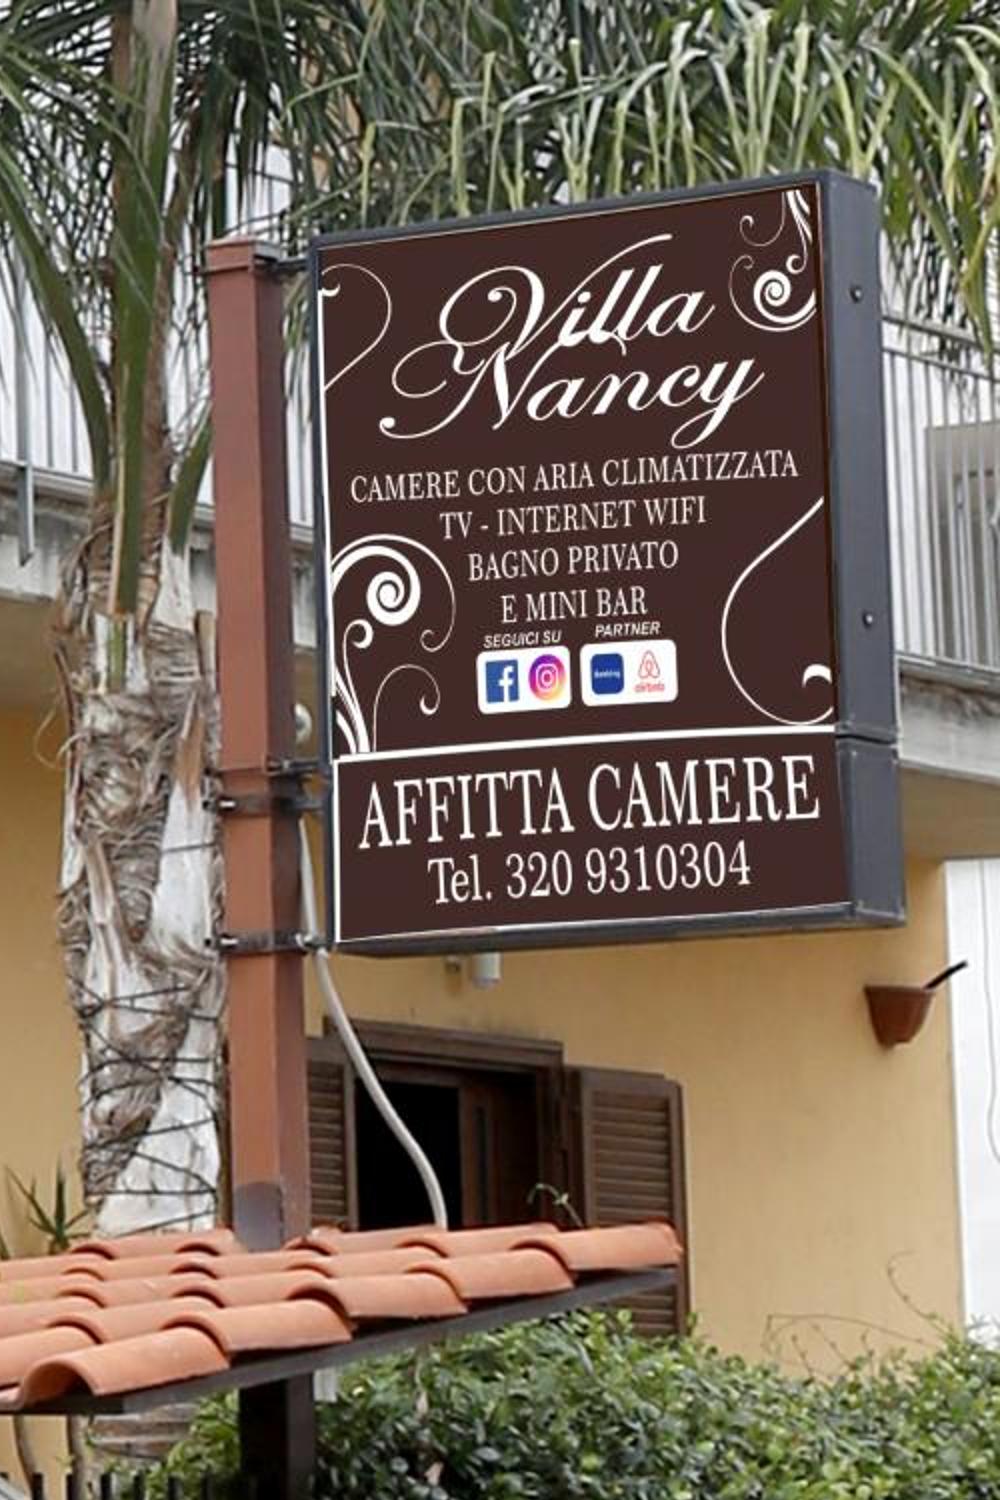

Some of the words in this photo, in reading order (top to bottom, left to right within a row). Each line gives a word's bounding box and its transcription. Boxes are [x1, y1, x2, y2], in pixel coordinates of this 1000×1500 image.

[439, 233, 715, 359] Villa
[378, 335, 765, 449] Nancy
[351, 470, 461, 503] CAMERE
[468, 466, 526, 496] CON
[533, 461, 595, 491] ARIA
[602, 449, 799, 487] CLIMATIZZATA
[439, 511, 473, 540] TV
[497, 499, 637, 536] INTERNET
[643, 495, 707, 526] WIFI
[468, 547, 560, 581] BAGNO
[567, 540, 679, 574] PRIVATO
[501, 594, 518, 624] E
[526, 589, 588, 622] MINI
[596, 585, 649, 617] BAR
[483, 631, 539, 649] SEGUICI
[543, 629, 563, 644] SU
[594, 621, 661, 638] PARTNER
[358, 766, 575, 849] AFFITTA
[587, 755, 821, 831] CAMERE
[427, 855, 493, 903] Tel.
[505, 849, 573, 900] 320
[585, 839, 751, 894] 9310304
